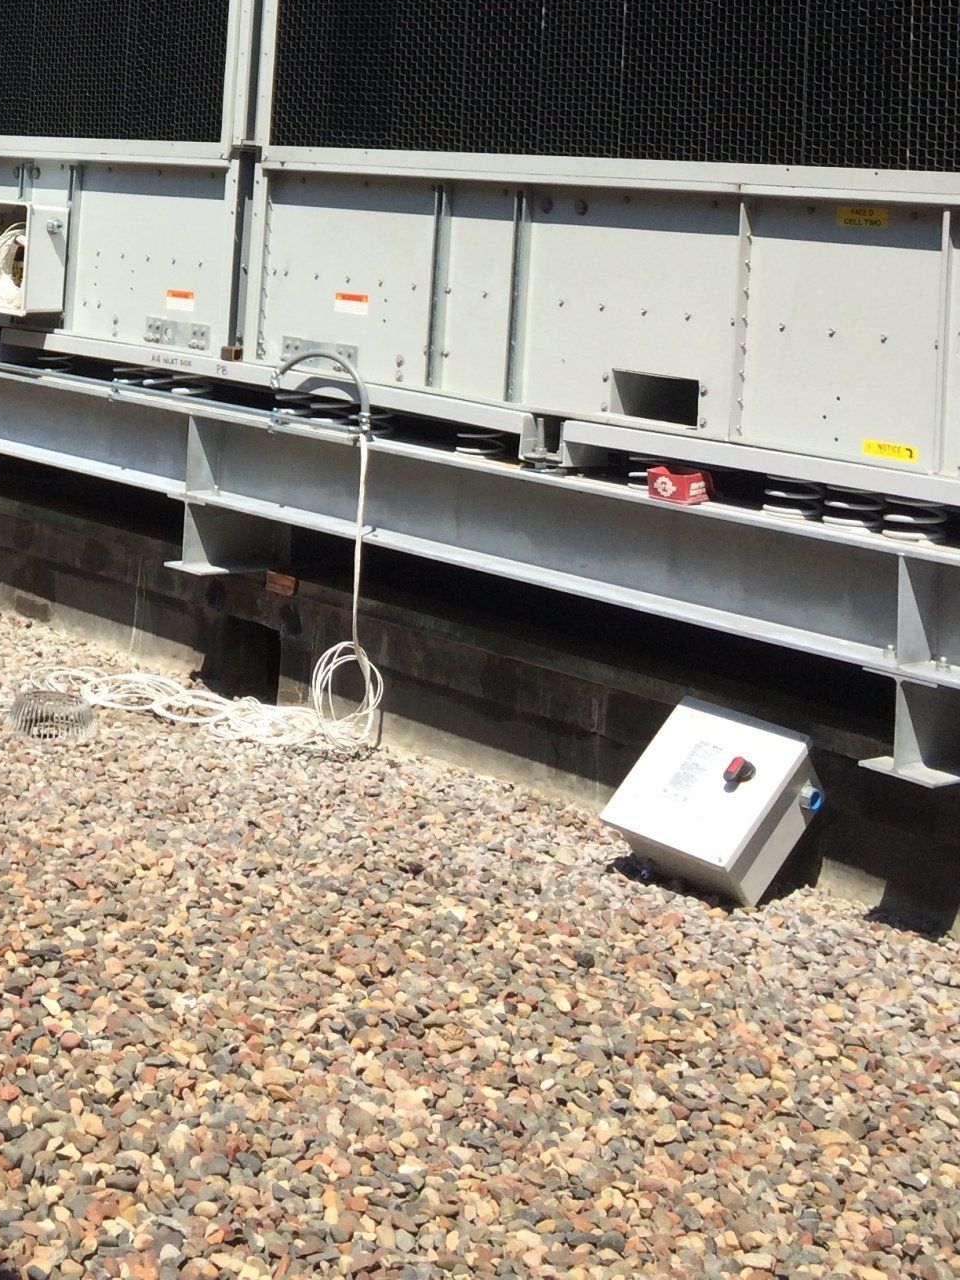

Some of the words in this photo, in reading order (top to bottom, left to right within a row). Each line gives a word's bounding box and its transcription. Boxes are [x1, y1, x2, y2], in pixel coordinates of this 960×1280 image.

[843, 218, 863, 226] CELL
[865, 218, 882, 227] TWO
[877, 443, 902, 454] NOTICE
